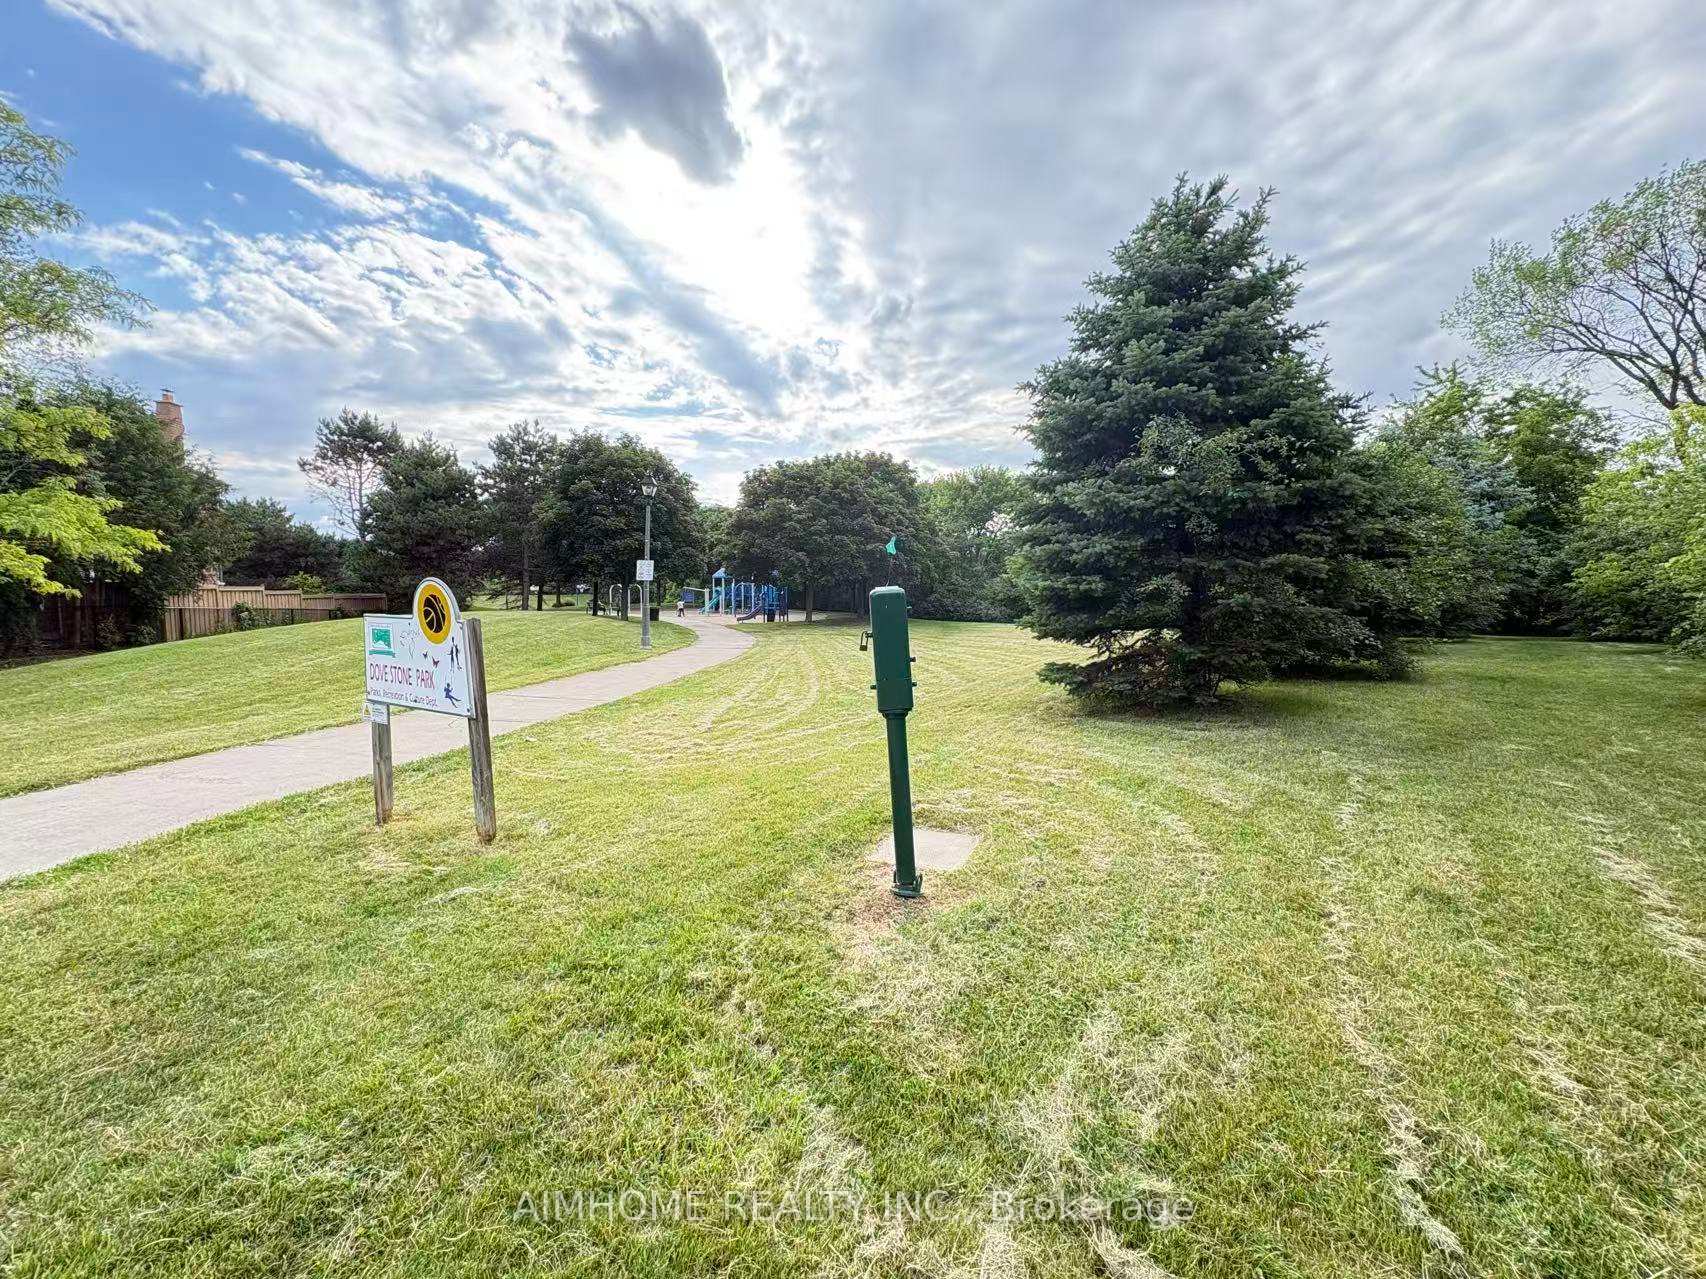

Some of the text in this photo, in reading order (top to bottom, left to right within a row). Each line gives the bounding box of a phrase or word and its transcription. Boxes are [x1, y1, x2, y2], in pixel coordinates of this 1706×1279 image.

[370, 663, 435, 689] DOVE STONE PARK
